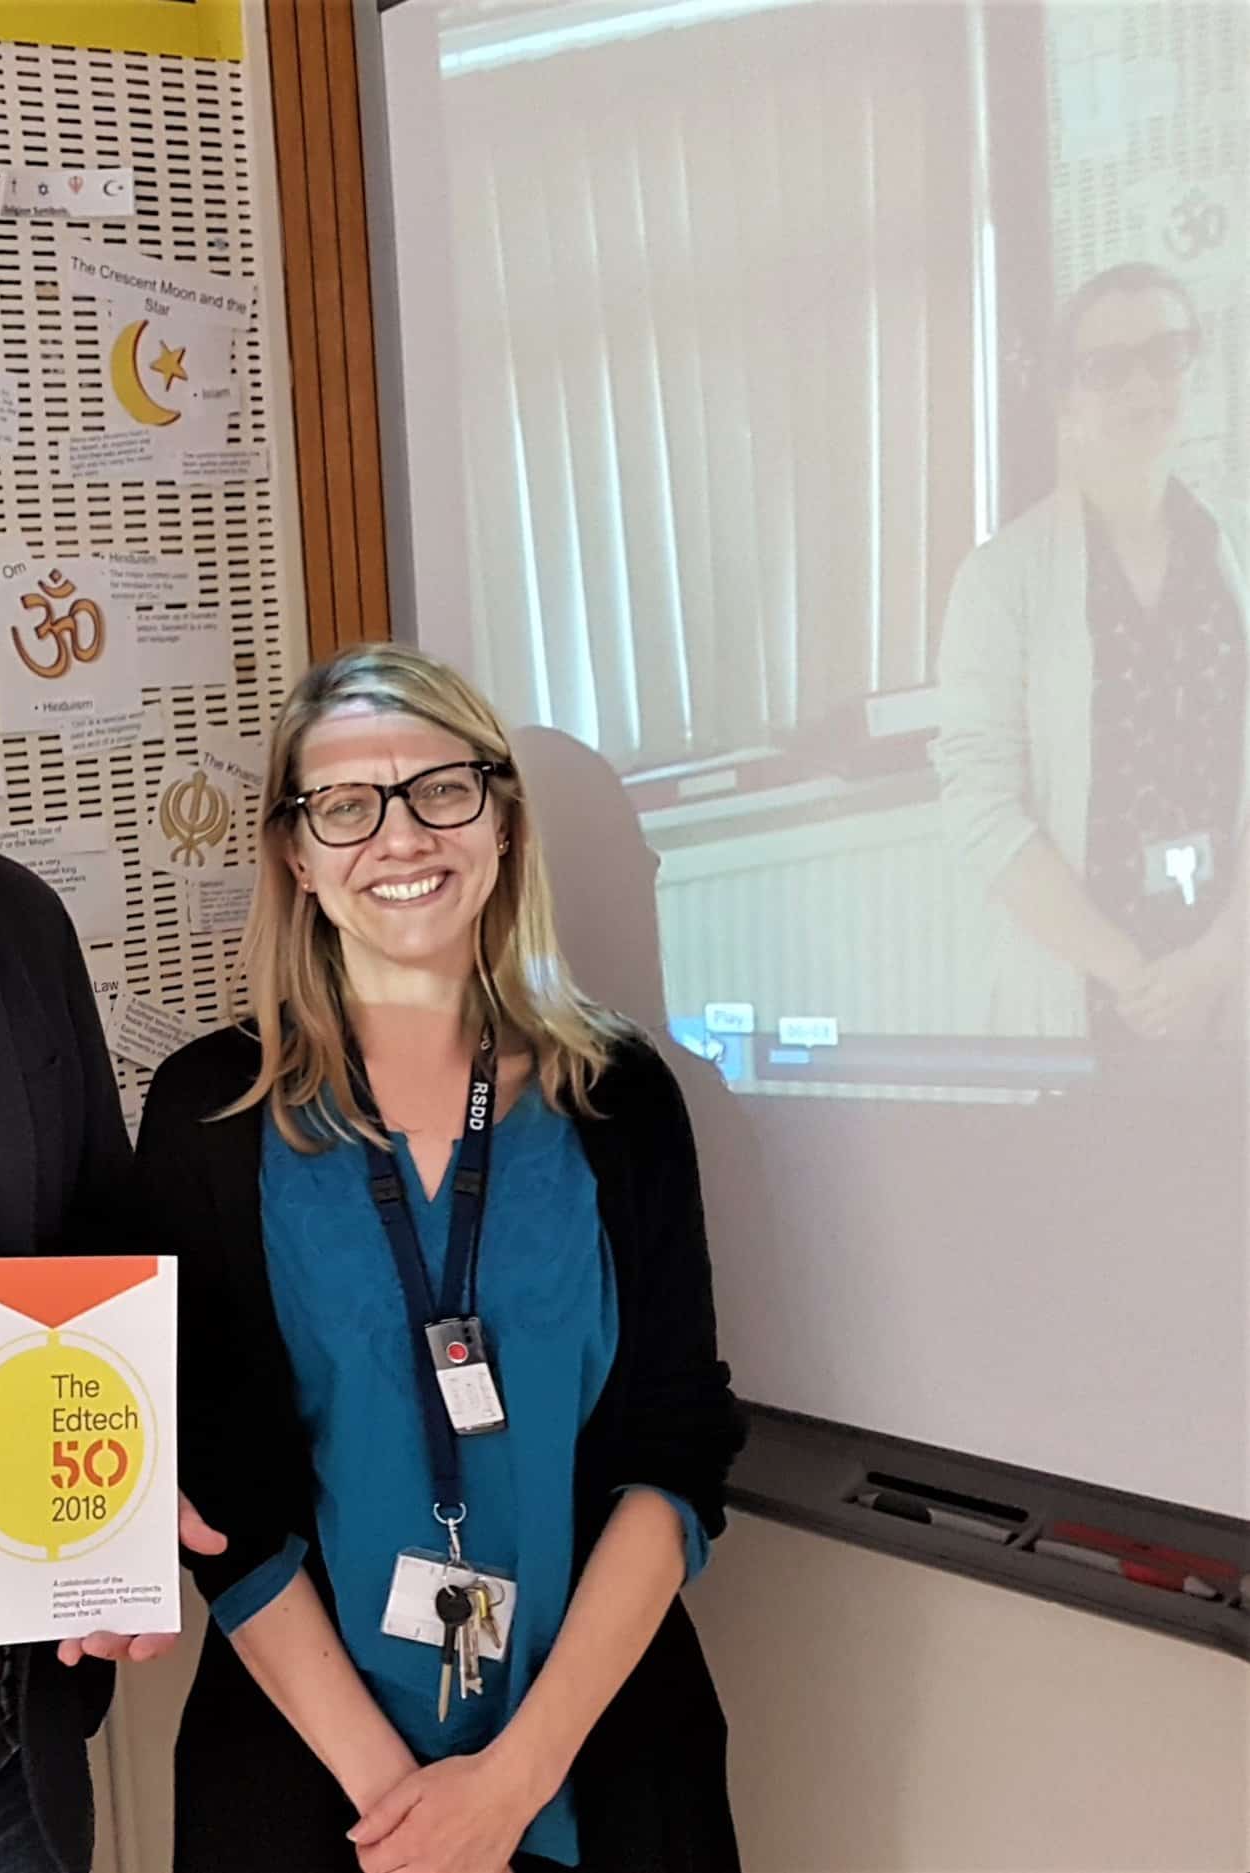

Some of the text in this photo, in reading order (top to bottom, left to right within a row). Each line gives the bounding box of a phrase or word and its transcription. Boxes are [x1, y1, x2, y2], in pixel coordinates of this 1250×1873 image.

[71, 256, 247, 314] The Crescent Moon and the
[144, 298, 171, 316] Star
[2, 562, 27, 579] Om
[43, 700, 93, 713] Hinduism
[204, 751, 224, 770] The
[94, 981, 119, 993] Law
[469, 1082, 489, 1131] RSDD
[51, 1373, 100, 1399] The
[53, 1404, 138, 1432] Edtech
[51, 1438, 129, 1489] 50
[52, 1494, 107, 1522] 2018
